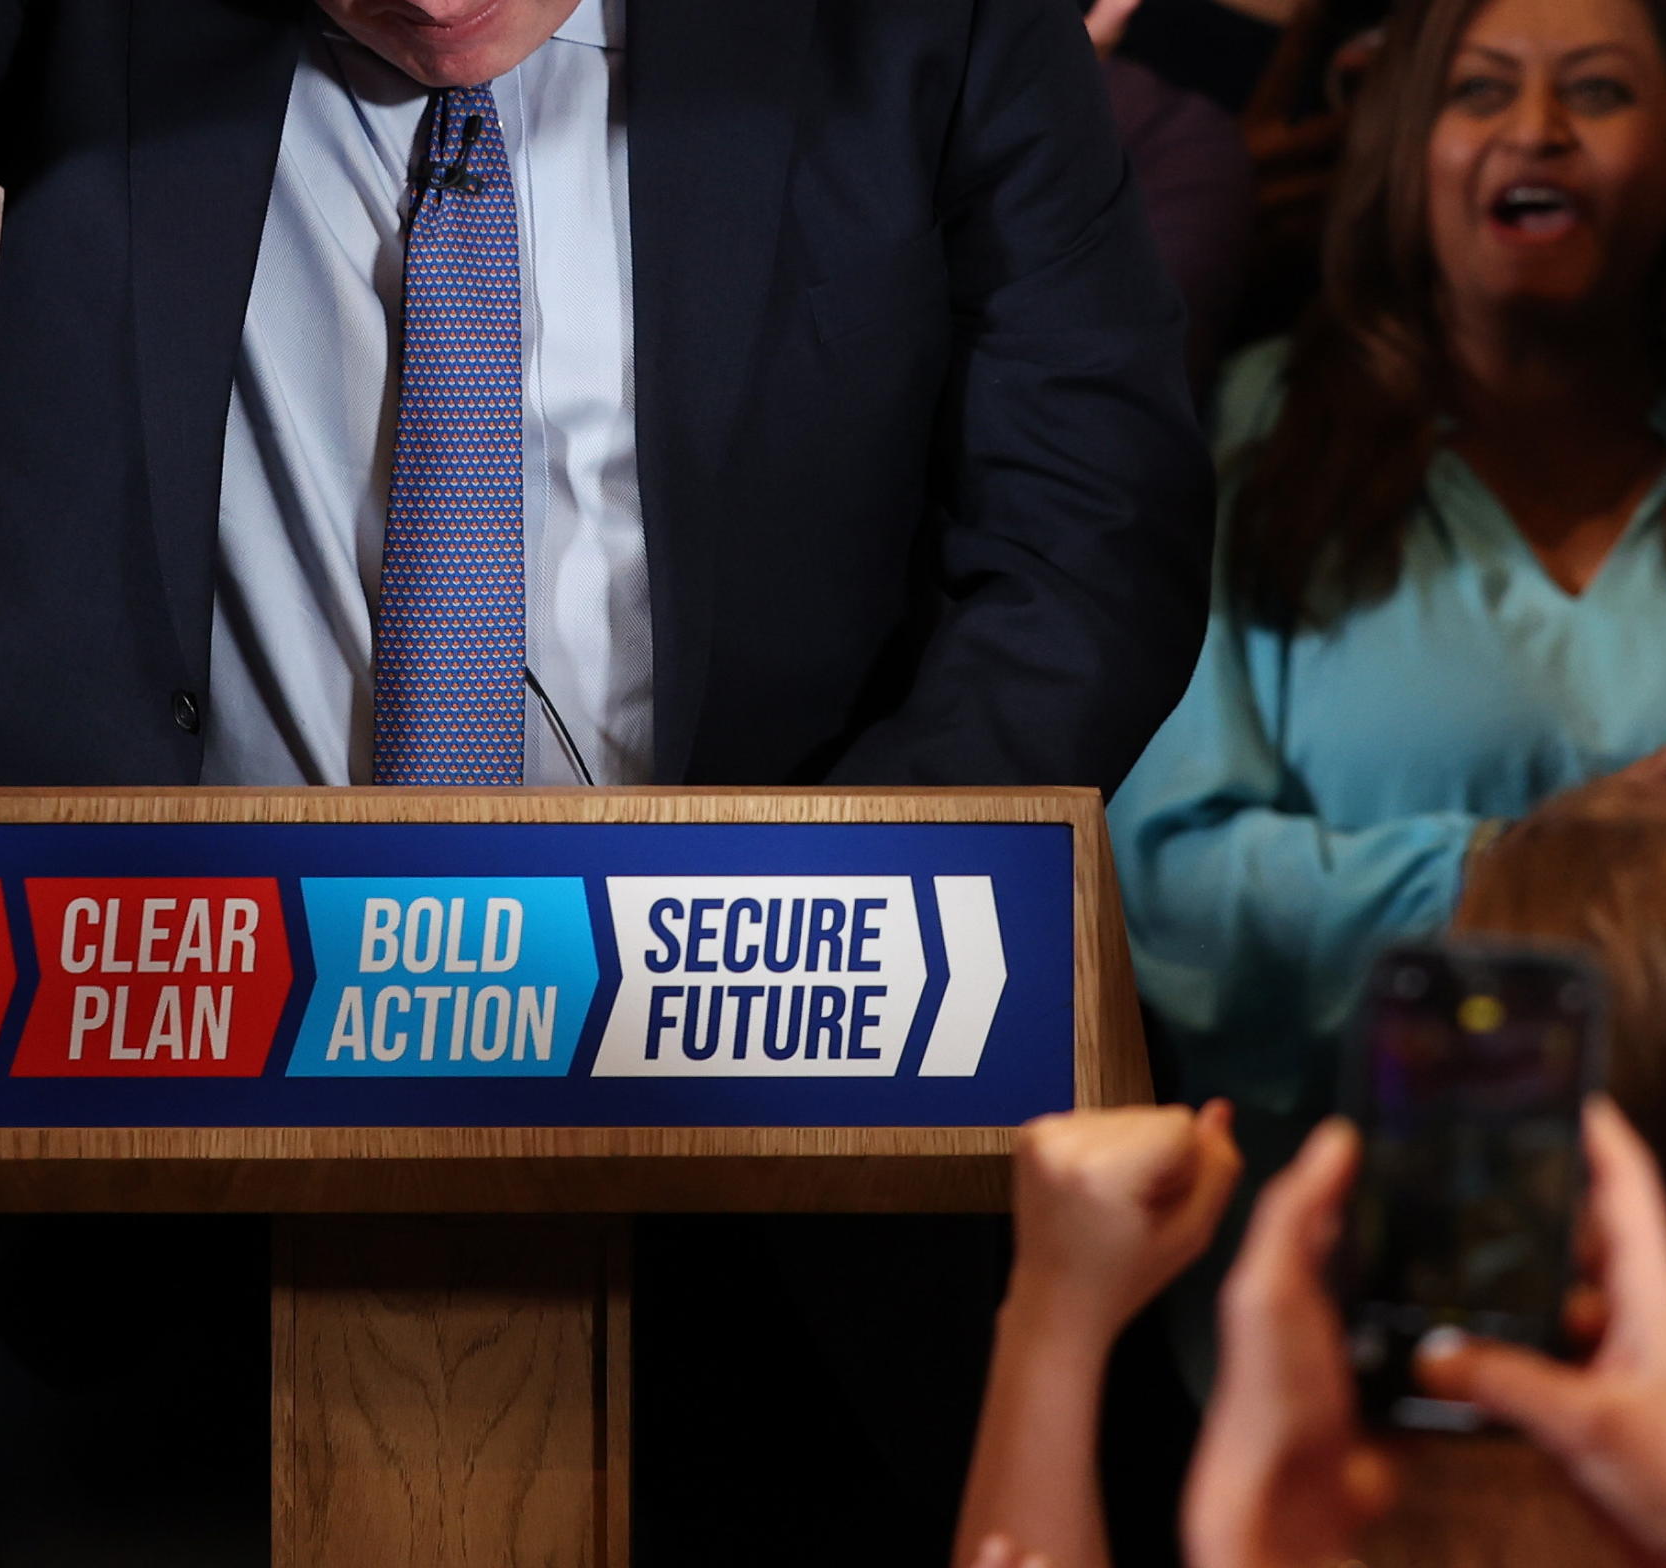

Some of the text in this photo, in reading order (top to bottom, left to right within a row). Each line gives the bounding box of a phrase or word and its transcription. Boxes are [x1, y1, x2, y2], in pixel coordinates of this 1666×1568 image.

[60, 897, 259, 973] CLEAR
[359, 896, 524, 973] BOLD
[644, 897, 888, 973] SECURE
[68, 985, 233, 1060] PLAN
[325, 985, 558, 1062] ACTION
[644, 985, 888, 1061] FUTURE
